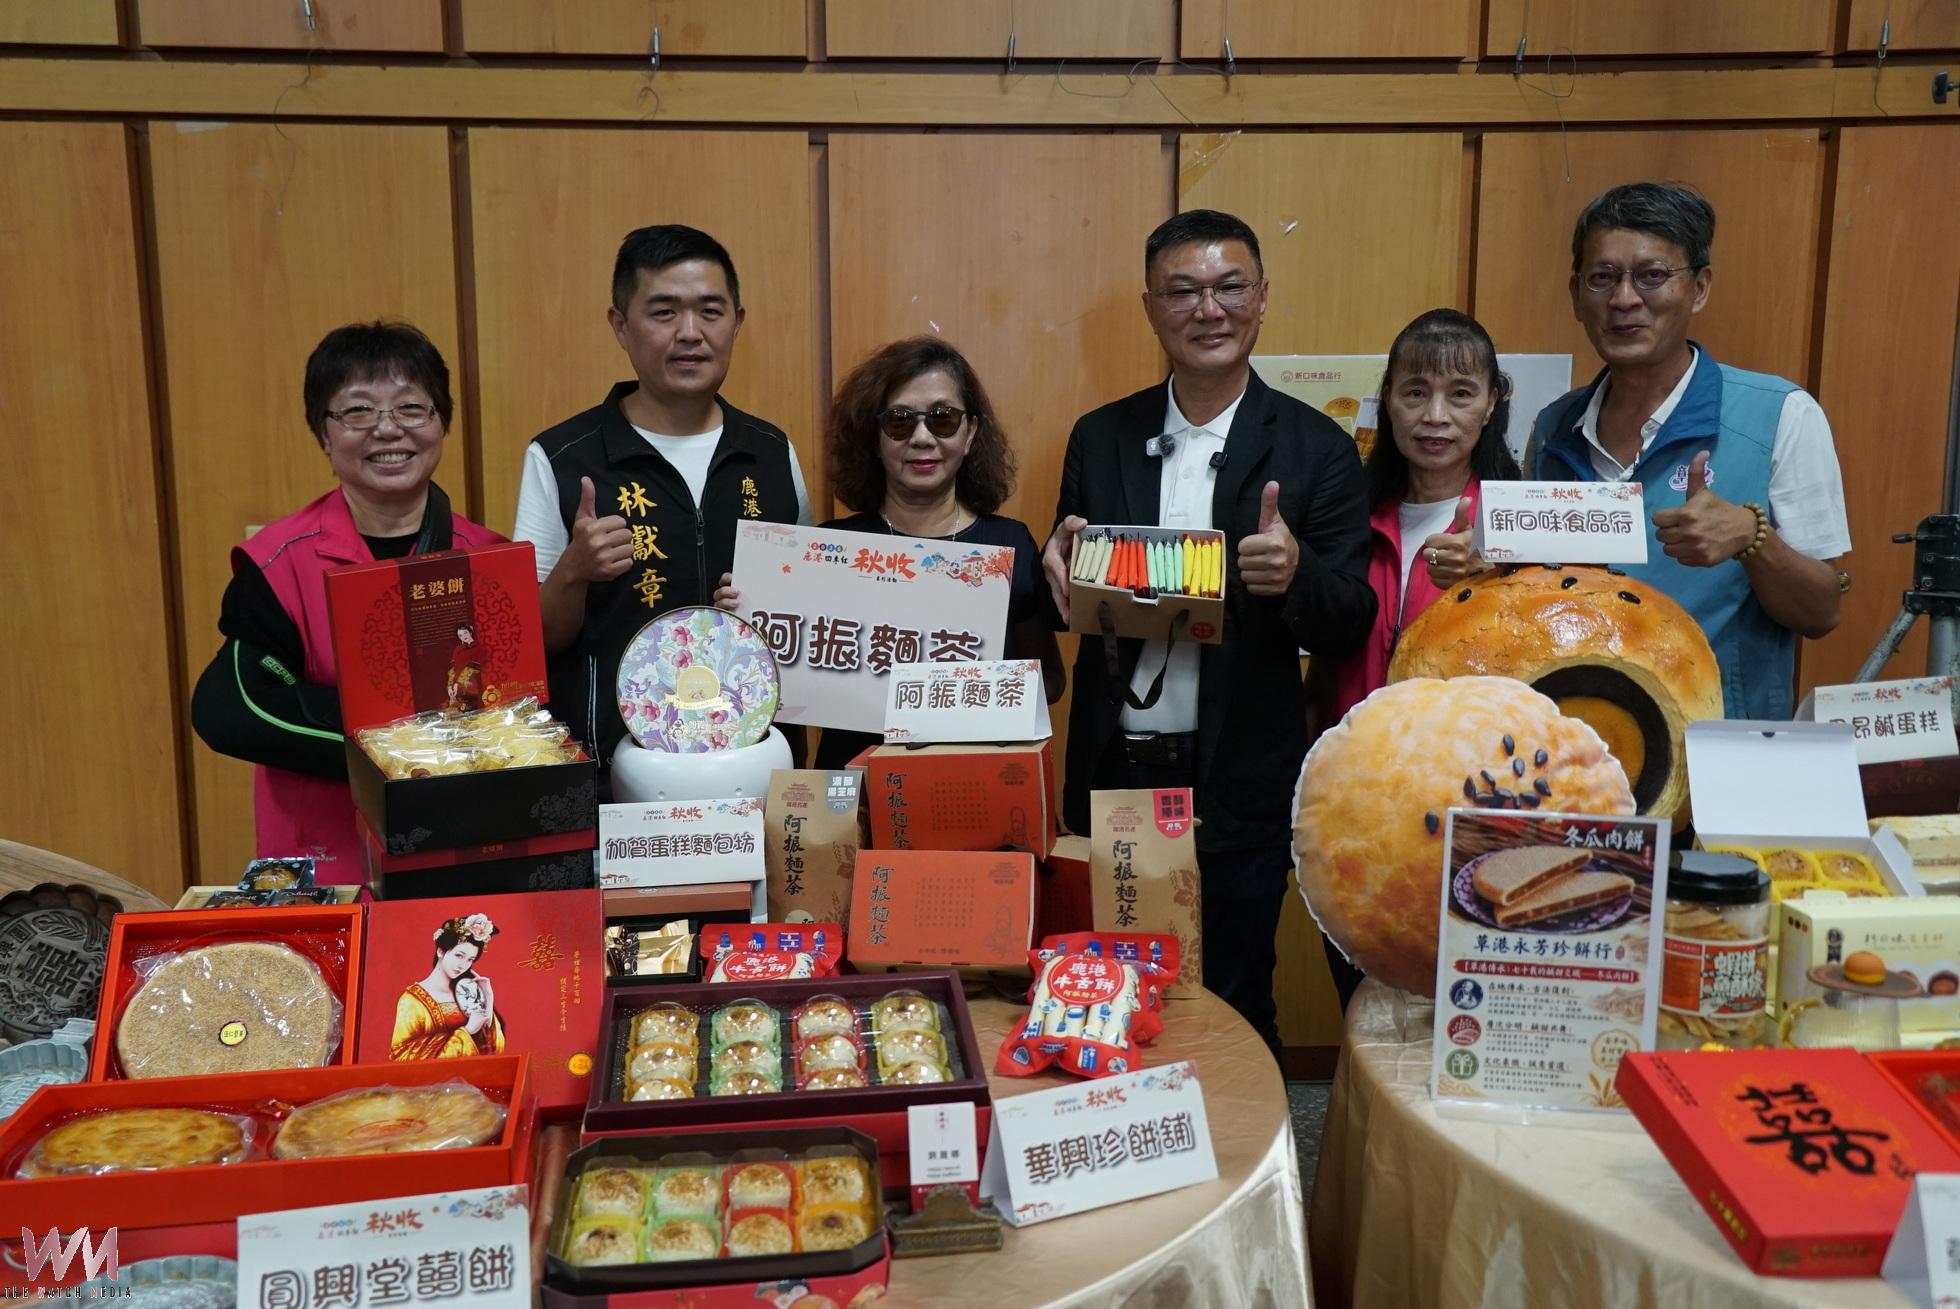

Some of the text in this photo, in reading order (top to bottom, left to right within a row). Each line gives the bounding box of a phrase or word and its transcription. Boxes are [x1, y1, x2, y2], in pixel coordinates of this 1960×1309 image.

[1295, 371, 1341, 381] 新口味食品行
[741, 476, 762, 521] 鹿港
[1551, 487, 1584, 500] 秋收
[1492, 510, 1633, 534] 新口味食品行
[617, 481, 668, 609] 林獻章
[849, 548, 917, 579] 秋收
[409, 577, 465, 600] 老婆餅
[752, 610, 979, 673] 阿振麵茶
[952, 667, 983, 679] 秋收
[897, 677, 1025, 710] 阿振麵茶
[1873, 687, 1902, 699] 秋收
[1829, 709, 1941, 740] 昂鹹蛋糕
[670, 806, 704, 820] 秋收
[885, 772, 909, 849] 阿振麵茶
[606, 832, 756, 860] 加賀蛋糕麵包坊
[1563, 825, 1645, 851] 冬瓜肉餅
[783, 814, 808, 897] 阿振麵茶
[1112, 840, 1138, 928] 阿振麵茶
[869, 865, 895, 945] 阿振麵茶
[1473, 935, 1613, 960] 草港永芳珍餅行
[1068, 961, 1108, 977] 鹿港
[1053, 973, 1116, 995] 牛舌餅
[1086, 1085, 1127, 1108] 秋收
[1023, 1112, 1193, 1181] 華興珍餅舖
[365, 1208, 425, 1234] 秋收
